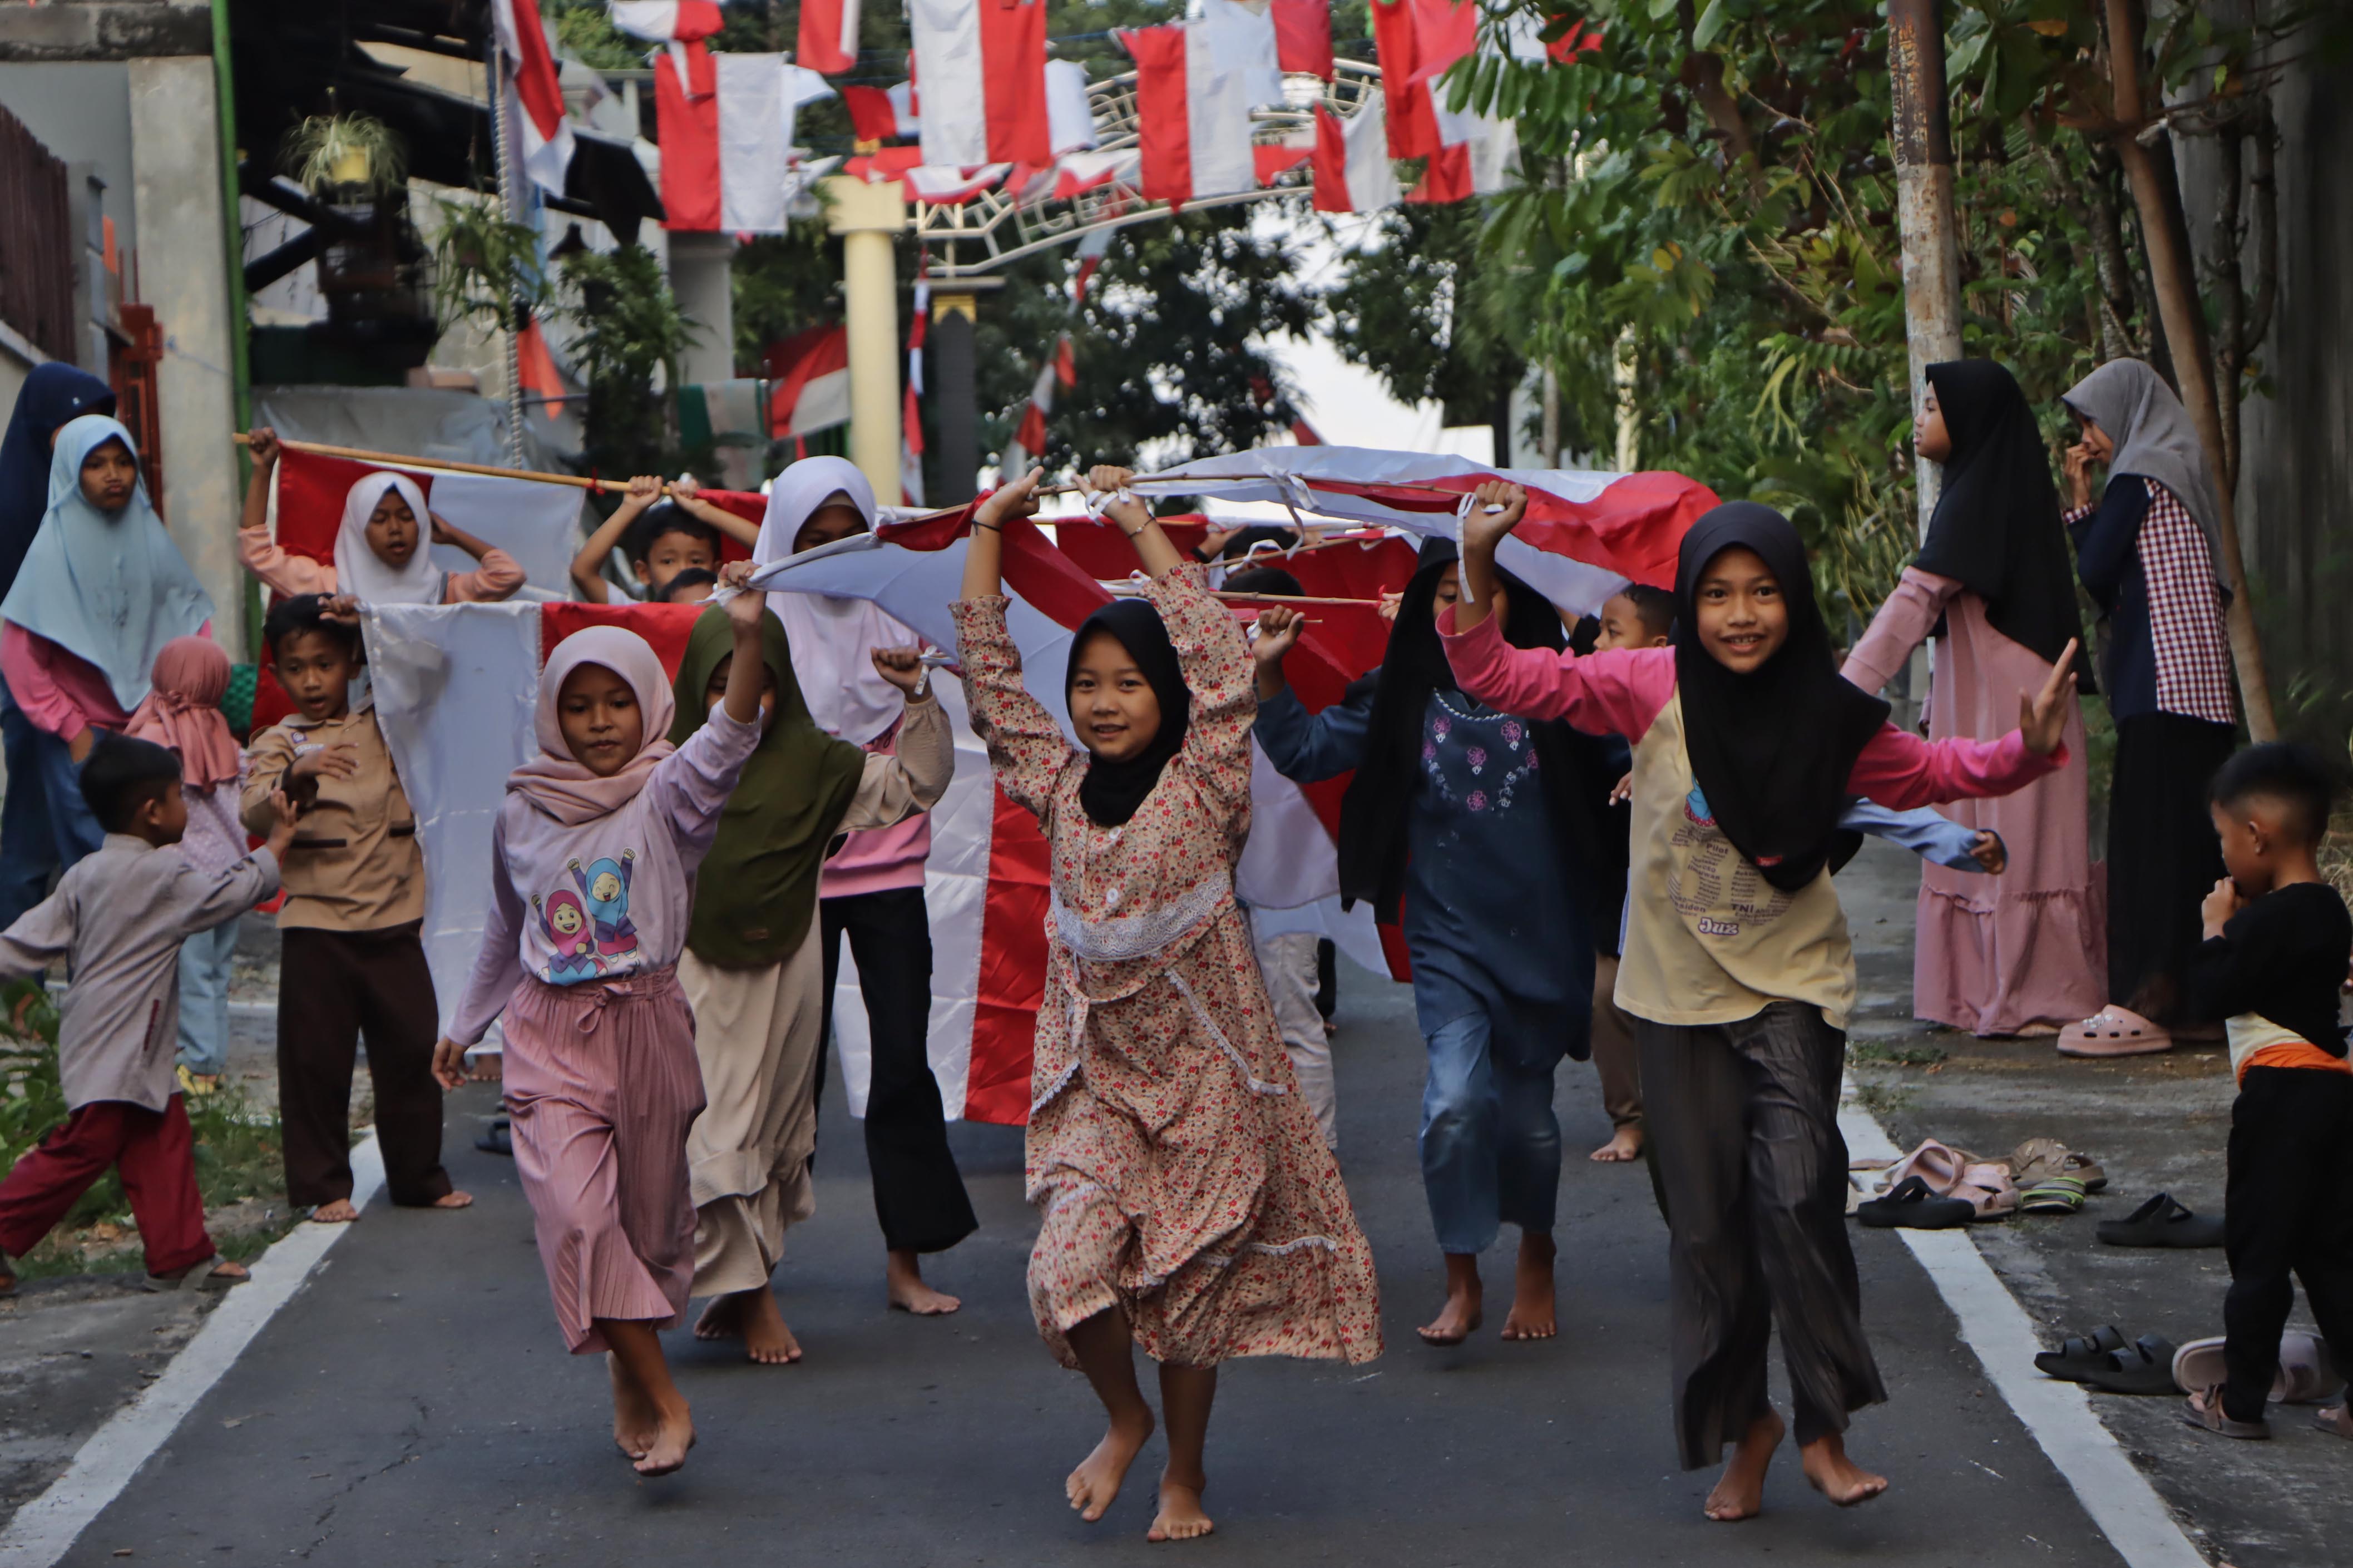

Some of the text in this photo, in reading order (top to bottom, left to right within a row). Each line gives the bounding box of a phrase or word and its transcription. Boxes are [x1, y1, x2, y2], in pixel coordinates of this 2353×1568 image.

[1707, 843, 1728, 854] Pilot
[1731, 903, 1754, 913] TNI
[1698, 917, 1739, 935] Juz
